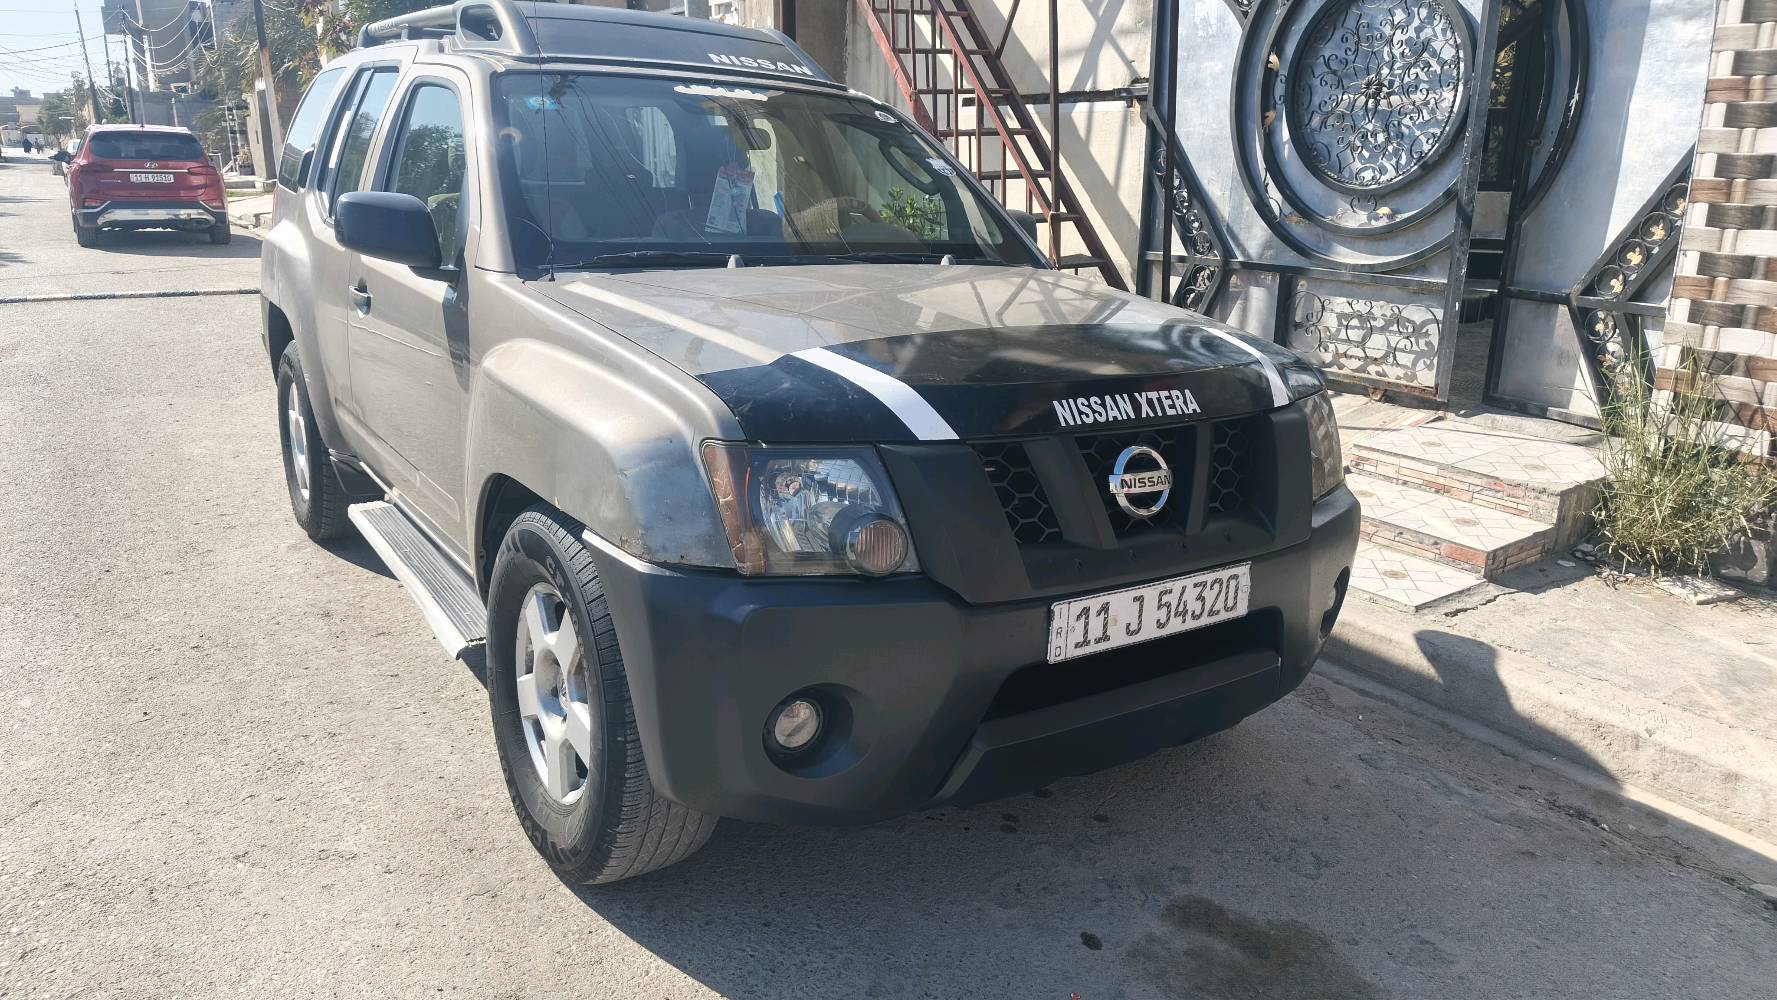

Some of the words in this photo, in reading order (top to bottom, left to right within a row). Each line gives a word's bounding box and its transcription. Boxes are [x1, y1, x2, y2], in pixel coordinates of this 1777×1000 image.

[708, 53, 814, 76] NISSAN
[134, 174, 143, 182] 11
[1053, 393, 1136, 426] NISSAN
[1134, 389, 1201, 418] XTERA
[1120, 473, 1172, 490] NISSAN
[1074, 601, 1111, 649] 11
[1125, 594, 1145, 637] J
[1156, 574, 1240, 629] 54320
